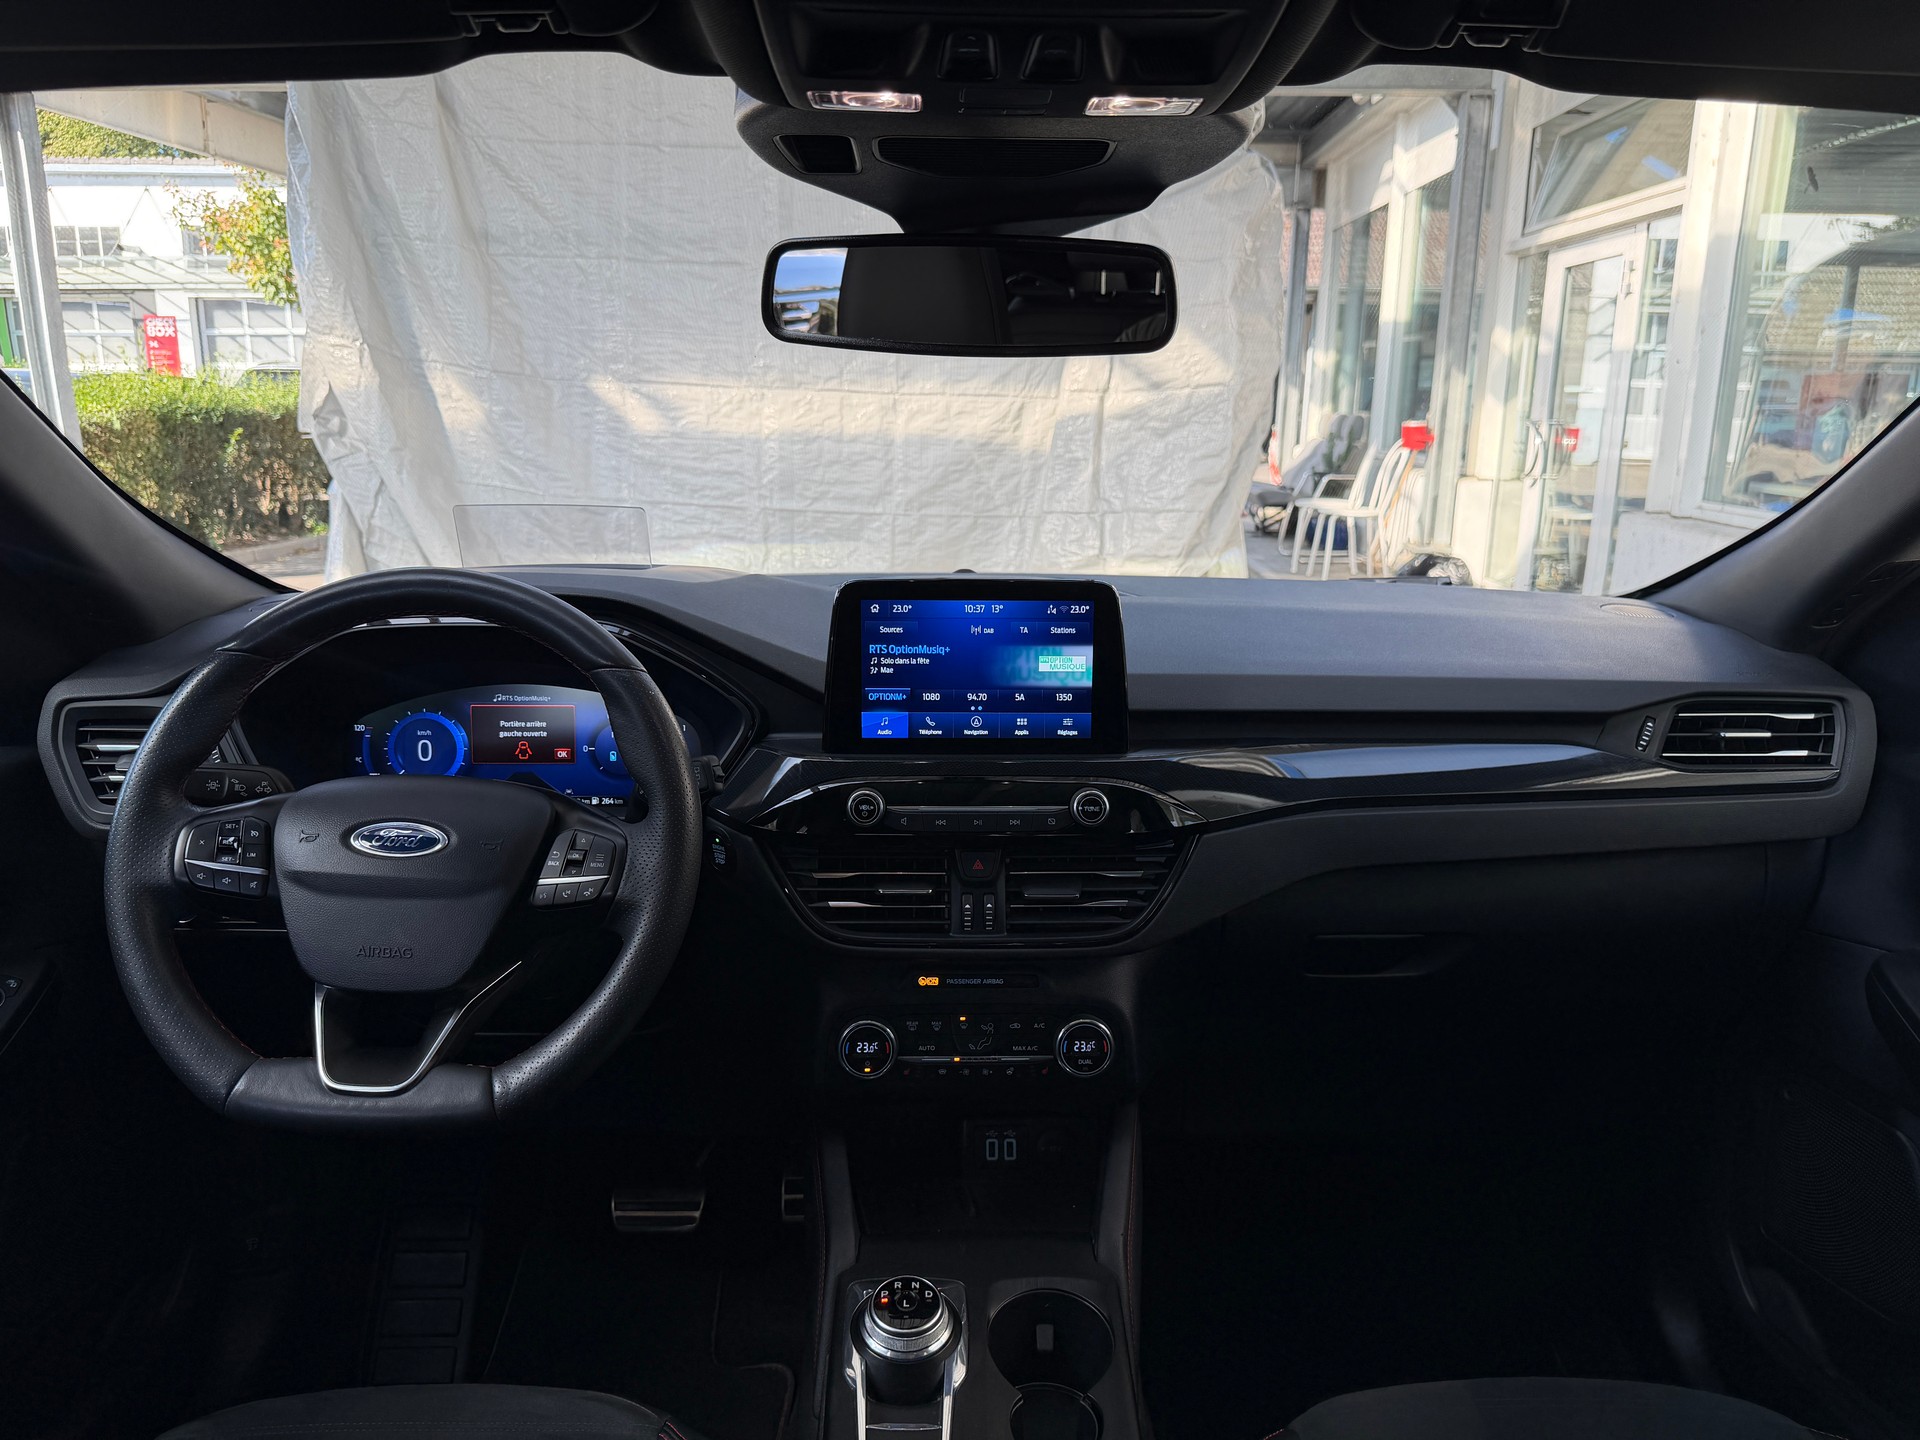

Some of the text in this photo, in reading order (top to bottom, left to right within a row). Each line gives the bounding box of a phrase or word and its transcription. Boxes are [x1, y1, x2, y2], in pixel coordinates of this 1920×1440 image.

[964, 604, 985, 613] 10:37
[1020, 626, 1029, 634] TA
[1050, 626, 1076, 634] Stations
[869, 644, 951, 656] RTS OptionMusiq+
[880, 657, 895, 665] Solo
[894, 657, 910, 665] dans
[910, 657, 917, 665] la
[880, 666, 894, 674] Mae
[1049, 663, 1086, 671] MUSIQUE
[868, 692, 907, 701] OPTIONM+
[922, 692, 941, 701] 1080
[967, 693, 988, 701] 94.70
[1015, 693, 1025, 701] 5A
[1055, 693, 1073, 702] 1350
[354, 724, 366, 732] 120
[500, 720, 547, 728] Portière arrière
[963, 729, 989, 737] Navigation
[417, 739, 433, 762] 0
[582, 745, 589, 753] 0
[556, 750, 568, 759] OK
[601, 797, 615, 805] 264
[371, 828, 424, 848] Ford
[356, 945, 414, 959] AIRBAG
[894, 1281, 902, 1289] R
[911, 1281, 920, 1289] N
[880, 1290, 889, 1298] P
[925, 1290, 933, 1298] D
[903, 1299, 910, 1308] L
